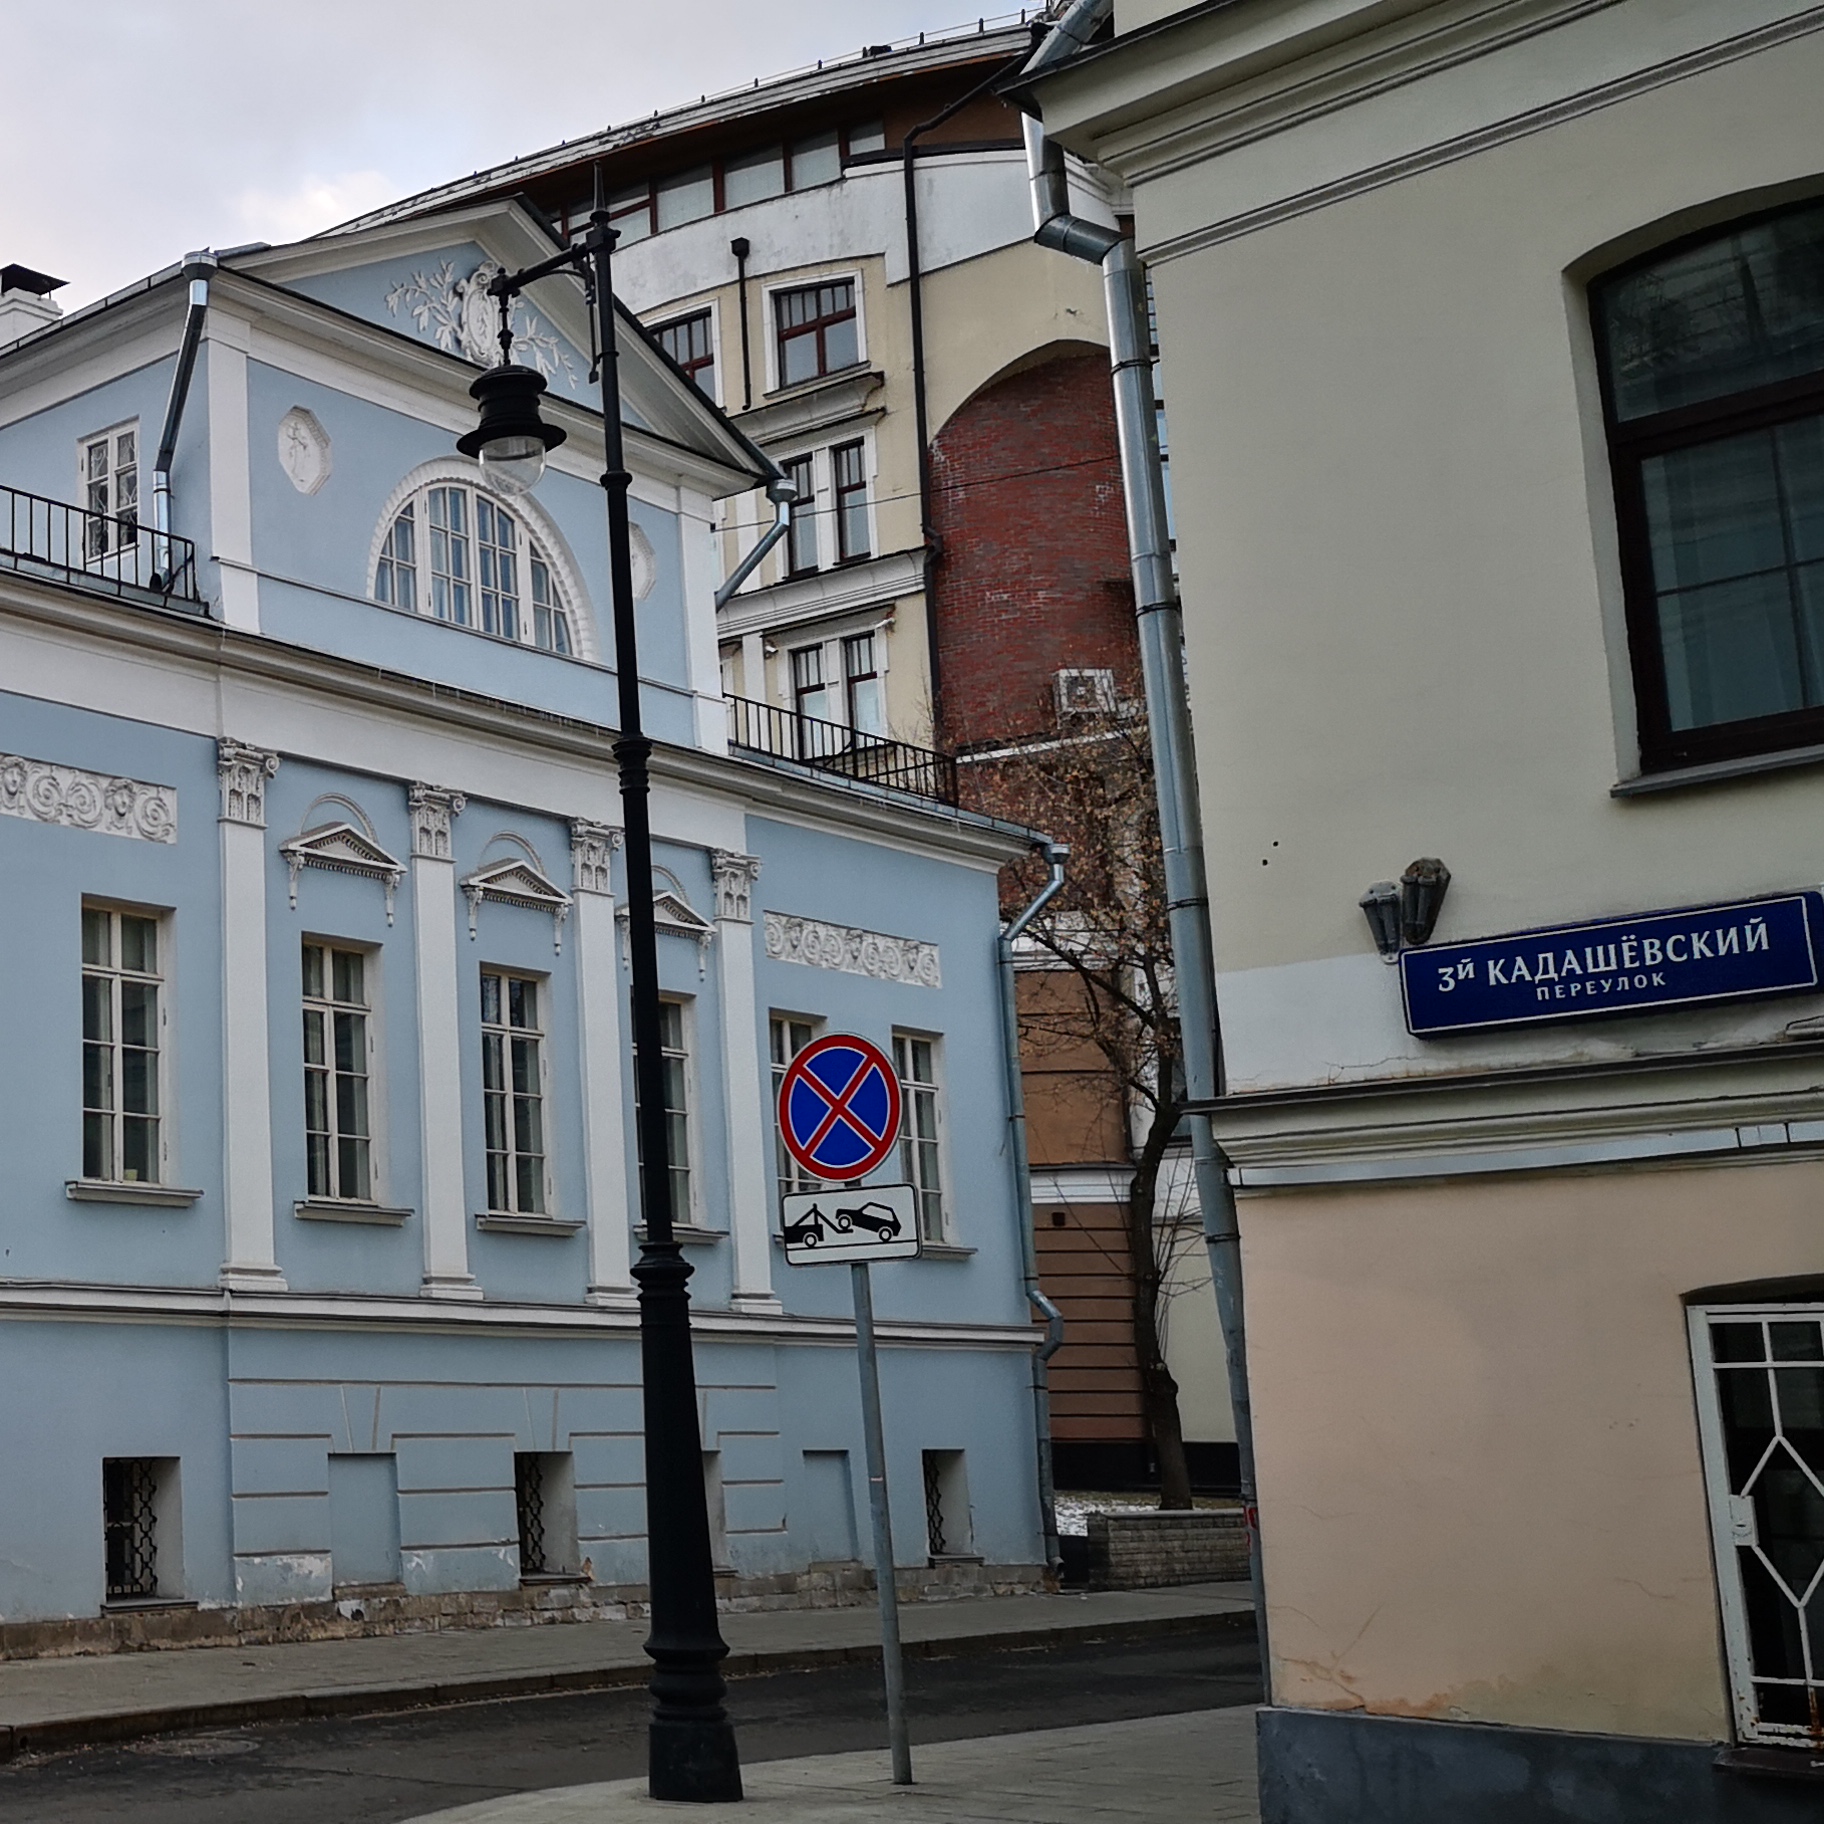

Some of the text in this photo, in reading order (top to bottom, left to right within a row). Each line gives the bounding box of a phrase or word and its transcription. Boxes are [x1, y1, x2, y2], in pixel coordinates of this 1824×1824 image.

[1437, 917, 1770, 993] 3й КАДАШЁВСКИЙ
[1536, 970, 1667, 1001] ПЕРЕУЛОК
